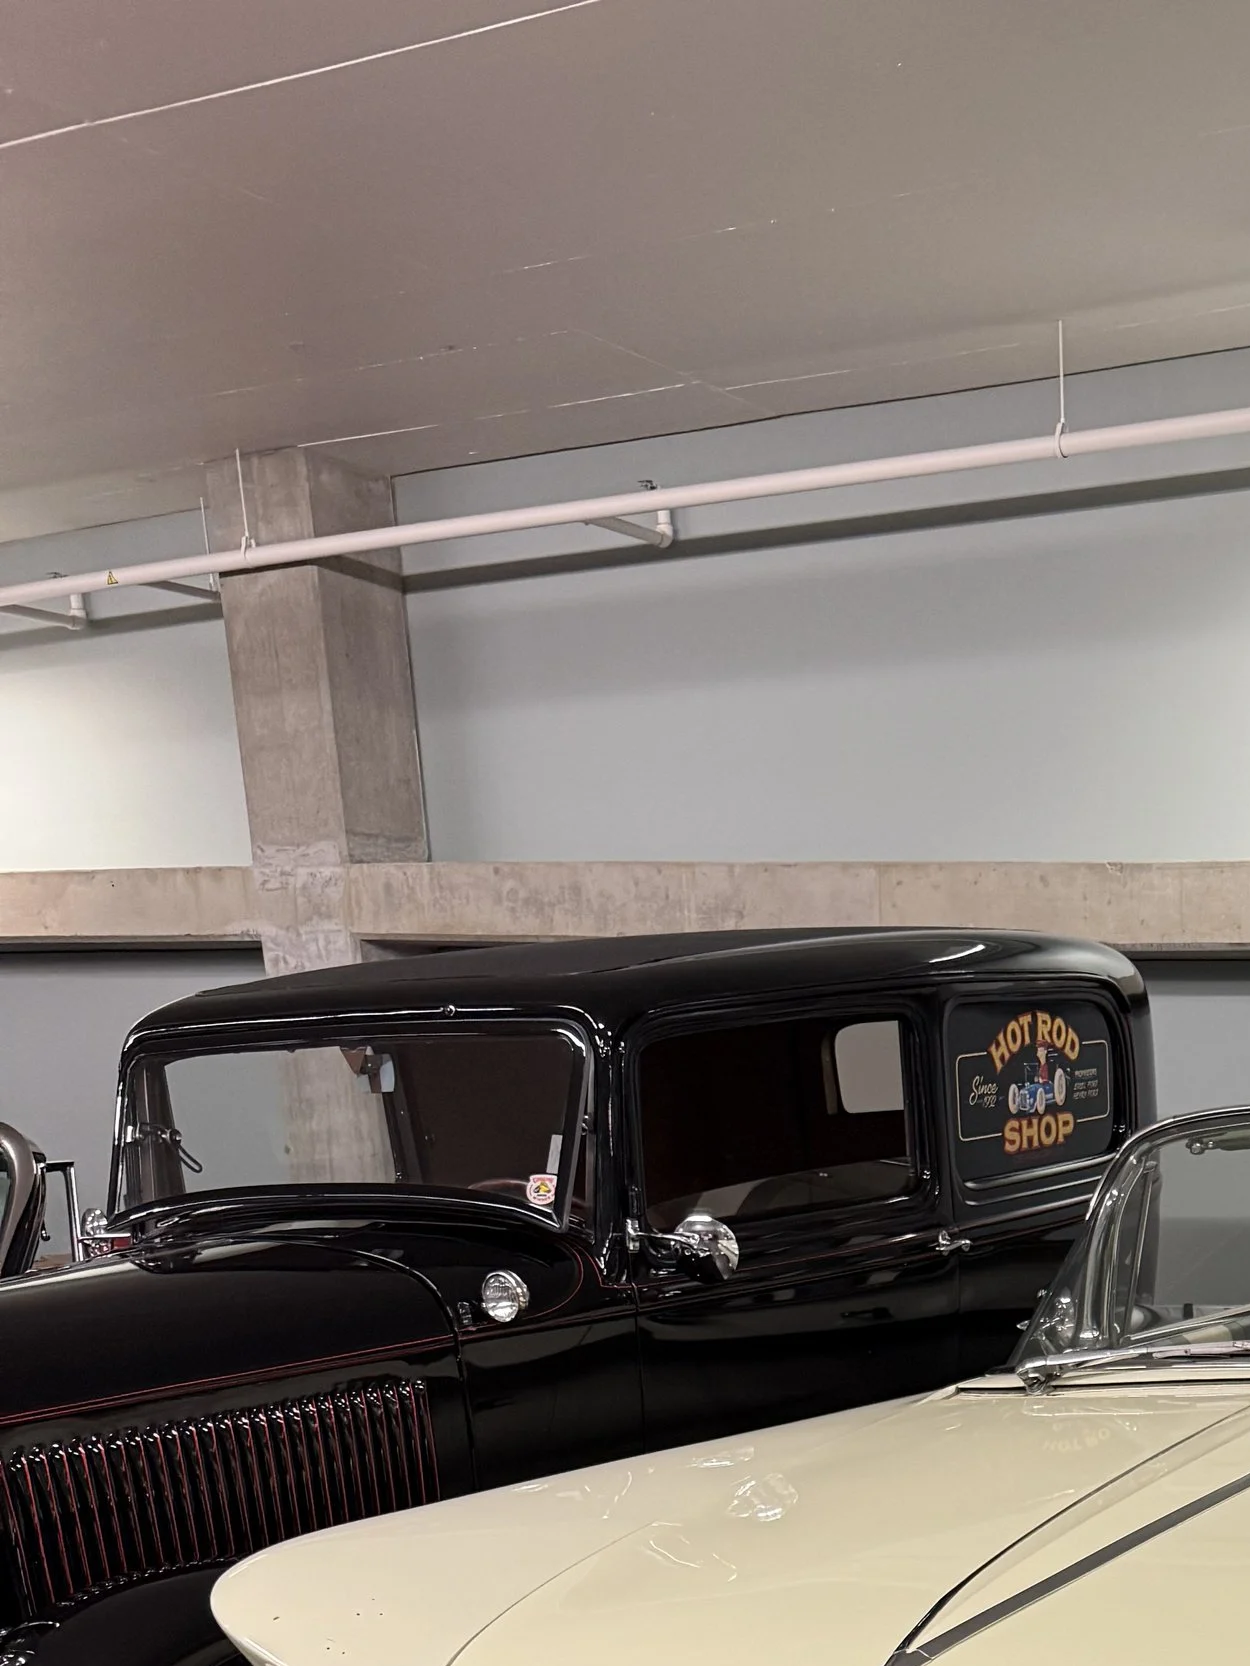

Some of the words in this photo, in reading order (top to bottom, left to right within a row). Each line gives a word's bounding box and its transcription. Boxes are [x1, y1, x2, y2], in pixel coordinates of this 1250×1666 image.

[988, 1011, 1033, 1074] HOT
[1036, 1010, 1080, 1060] ROD
[969, 1075, 998, 1105] Since
[1003, 1112, 1074, 1153] SHOP
